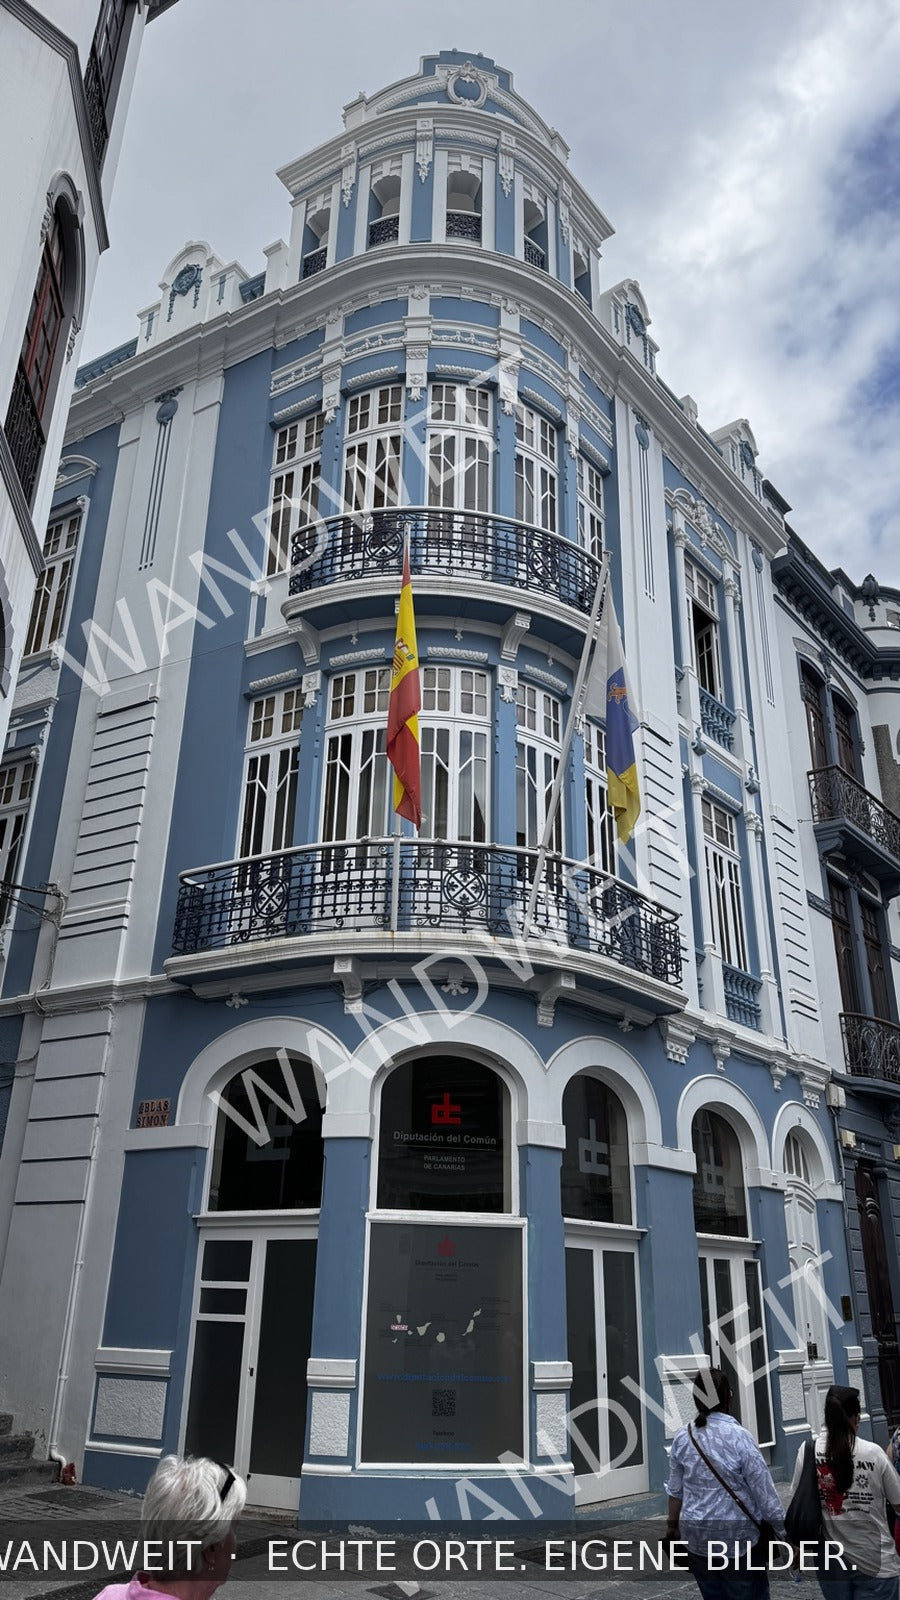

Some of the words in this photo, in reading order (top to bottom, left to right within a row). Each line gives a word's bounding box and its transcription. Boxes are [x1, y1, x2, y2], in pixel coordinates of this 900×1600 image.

[393, 1131, 444, 1141] Diputación
[447, 1135, 461, 1143] del
[464, 1135, 496, 1145] Común
[424, 1155, 466, 1163] PARLAMENTO
[433, 1163, 465, 1171] CANARIAS
